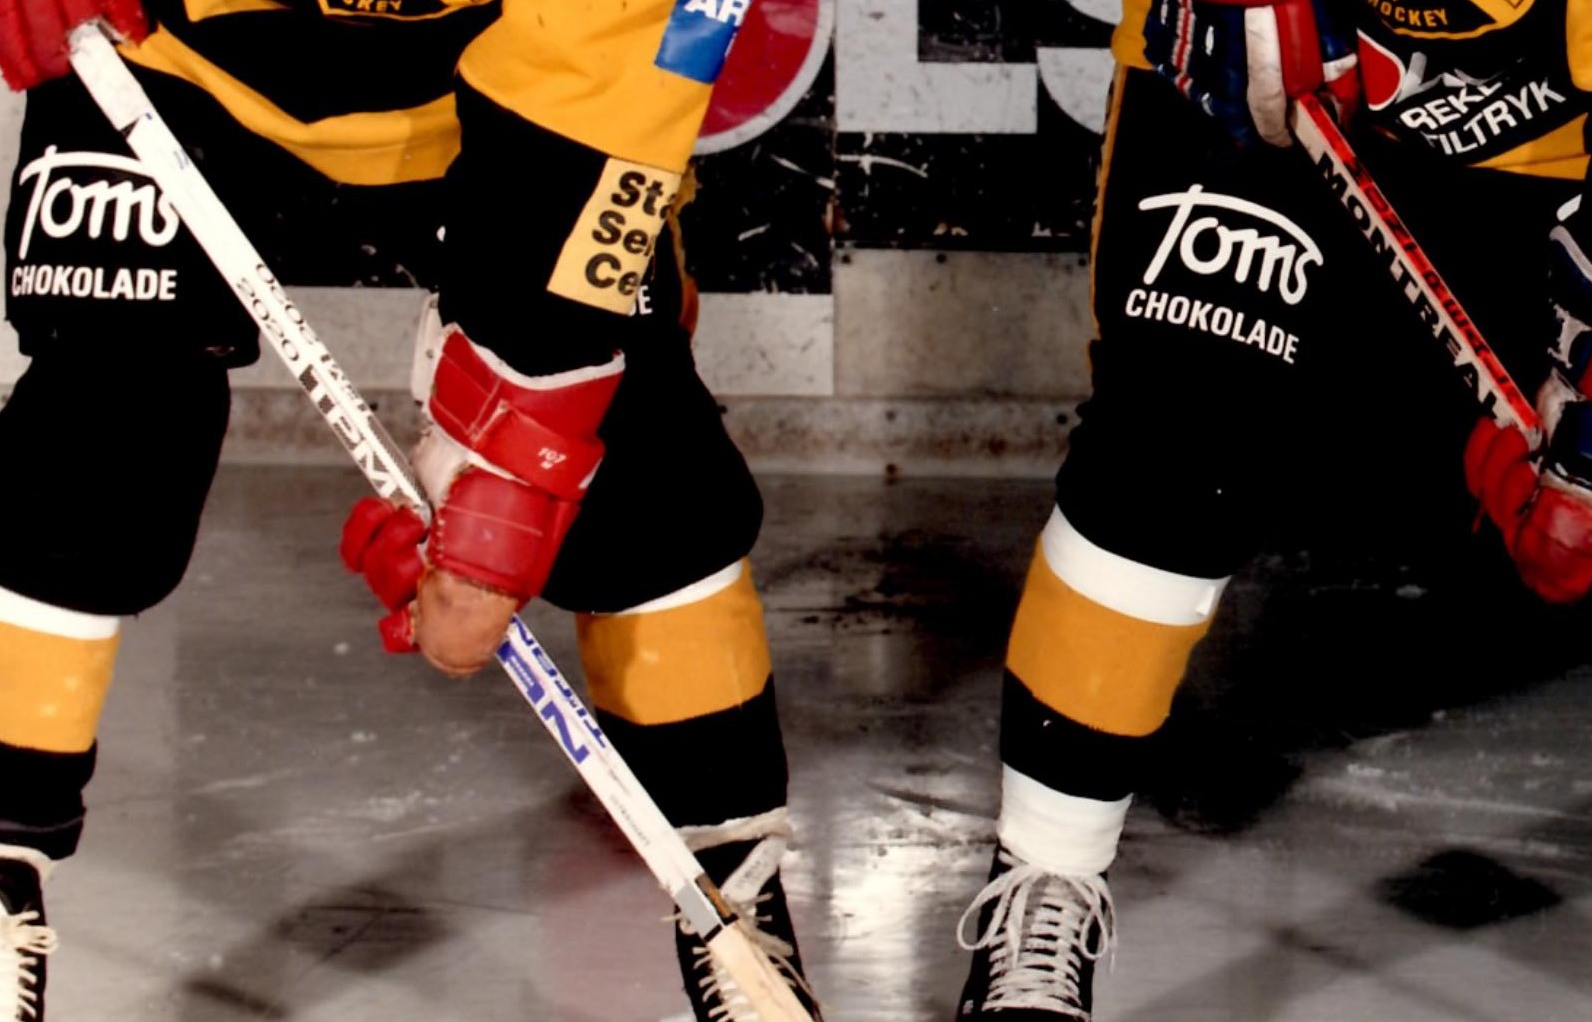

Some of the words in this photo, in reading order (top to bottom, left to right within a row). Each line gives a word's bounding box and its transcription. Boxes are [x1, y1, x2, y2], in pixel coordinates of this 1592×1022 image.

[12, 264, 178, 300] CHOKOLADE
[1139, 184, 1324, 305] Toms
[1314, 158, 1518, 421] MONTREAL
[1125, 288, 1300, 365] CHOKOLADE
